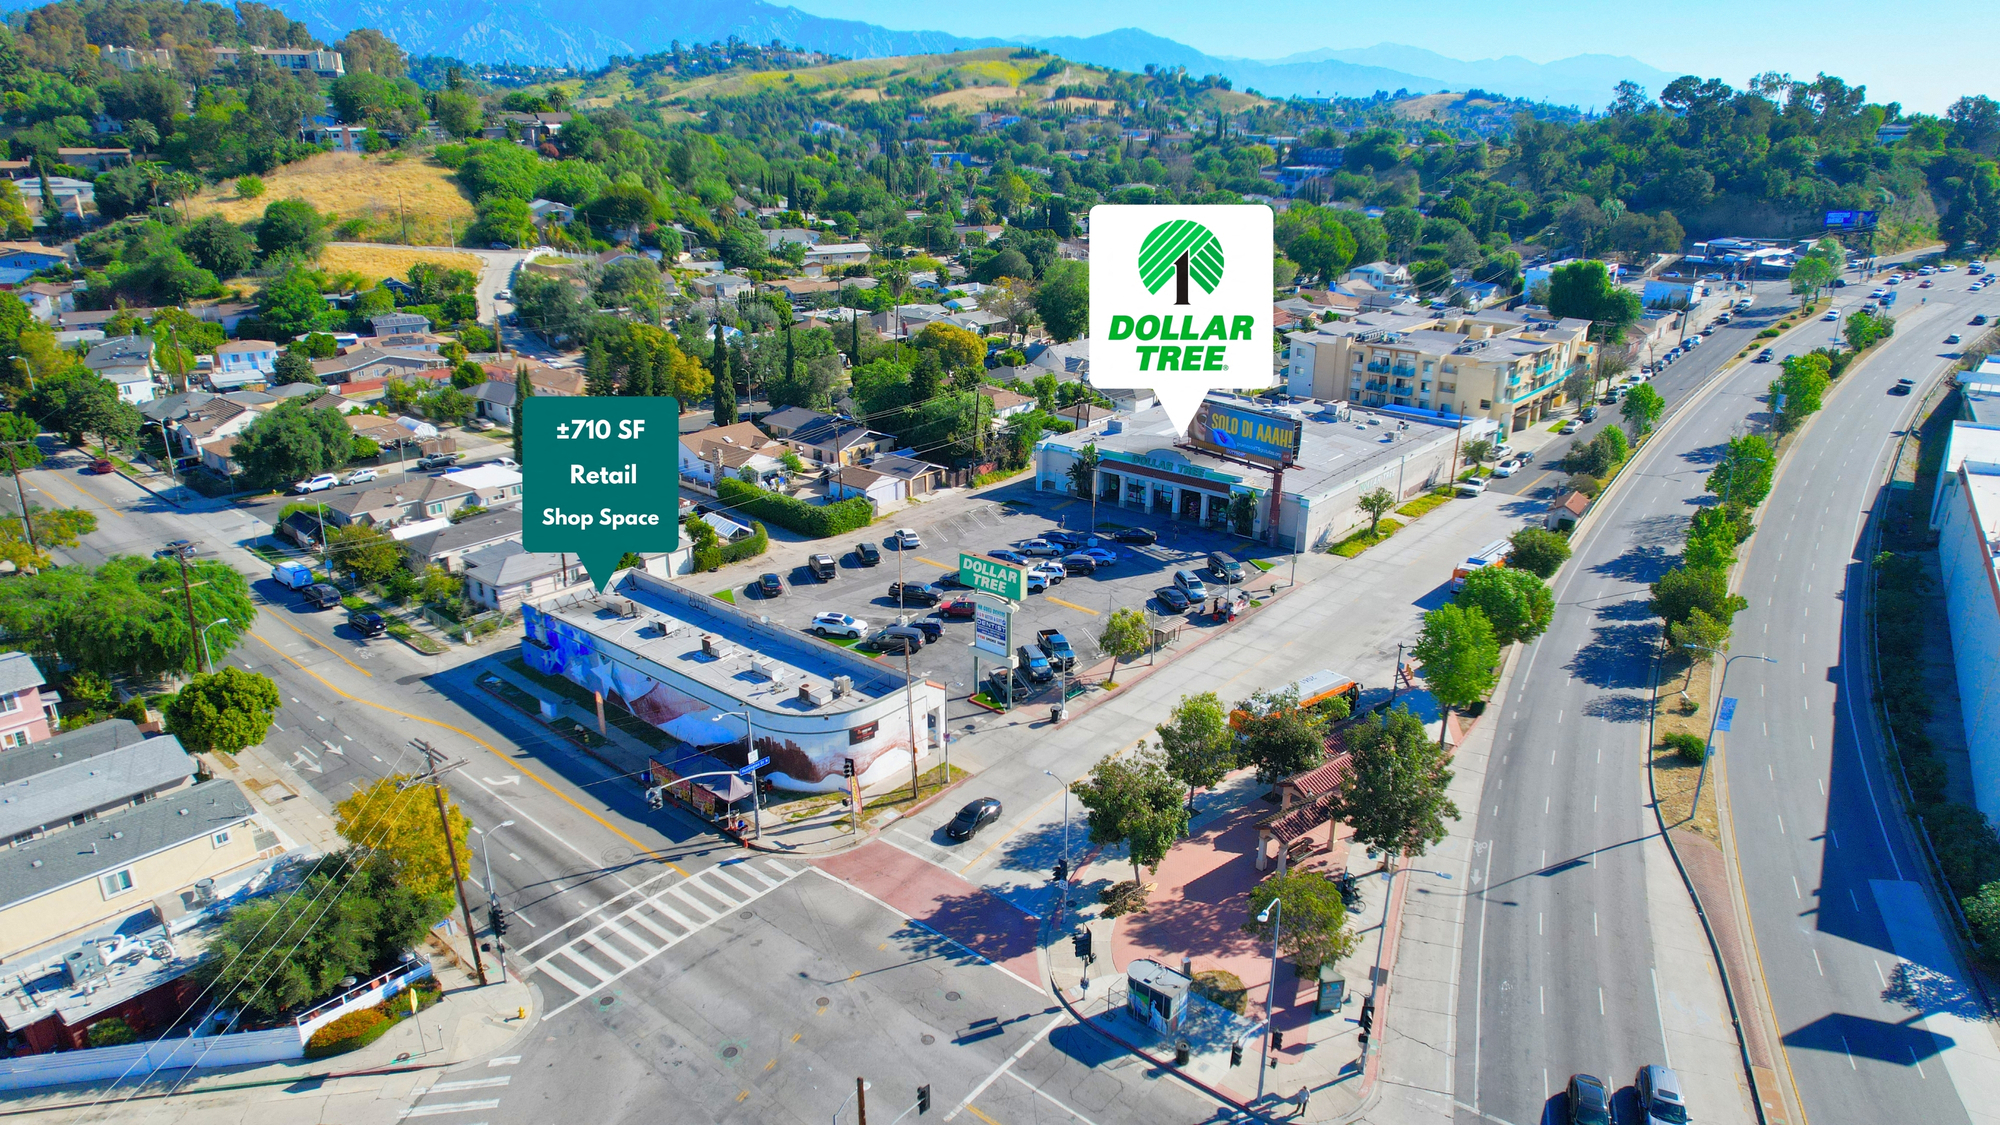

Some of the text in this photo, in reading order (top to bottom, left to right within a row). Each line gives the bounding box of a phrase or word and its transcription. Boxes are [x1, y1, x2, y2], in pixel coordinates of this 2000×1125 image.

[1212, 412, 1293, 448] SOLO DI AAAH!
[1132, 454, 1206, 478] DOLLAR TREE
[963, 558, 1018, 584] DOLLAR
[973, 573, 1007, 594] TREE
[977, 618, 1006, 632] DENTIST
